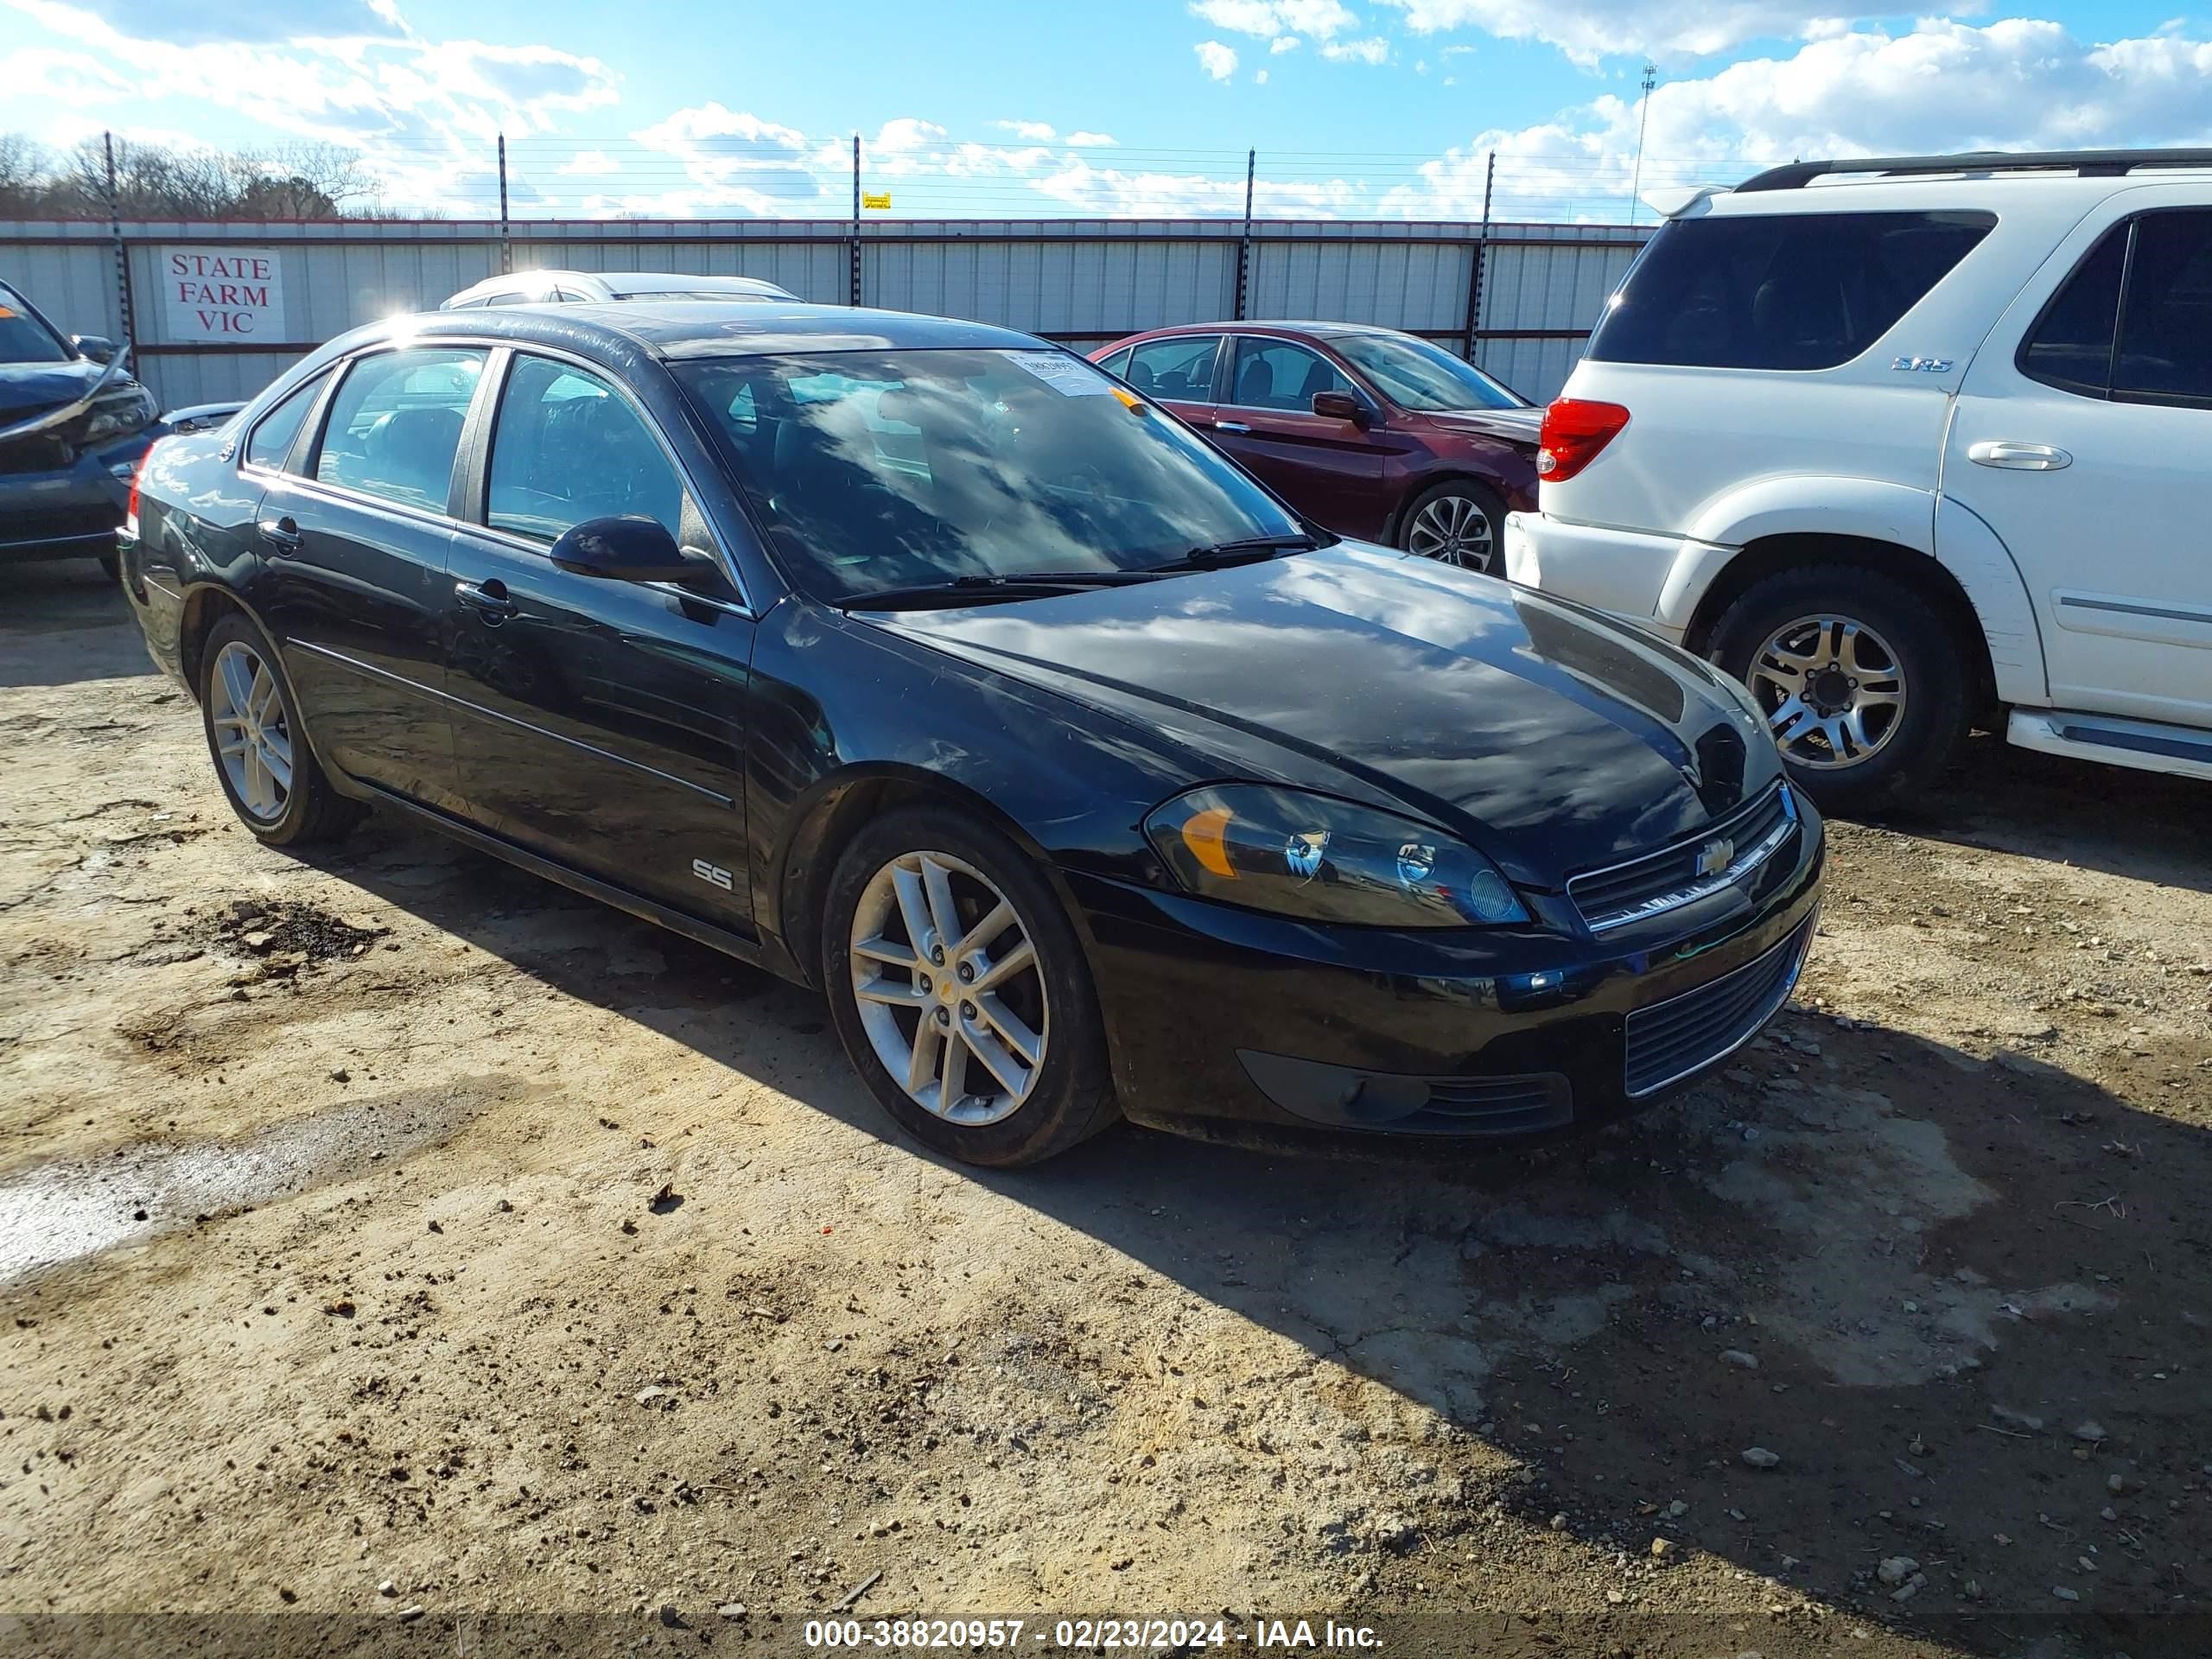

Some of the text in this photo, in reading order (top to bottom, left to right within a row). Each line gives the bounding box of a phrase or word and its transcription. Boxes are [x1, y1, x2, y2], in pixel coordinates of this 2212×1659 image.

[172, 253, 272, 280] STATE
[178, 282, 270, 308] FARM
[196, 310, 255, 334] VIC
[1891, 355, 1954, 372] SR5
[692, 858, 733, 890] SS
